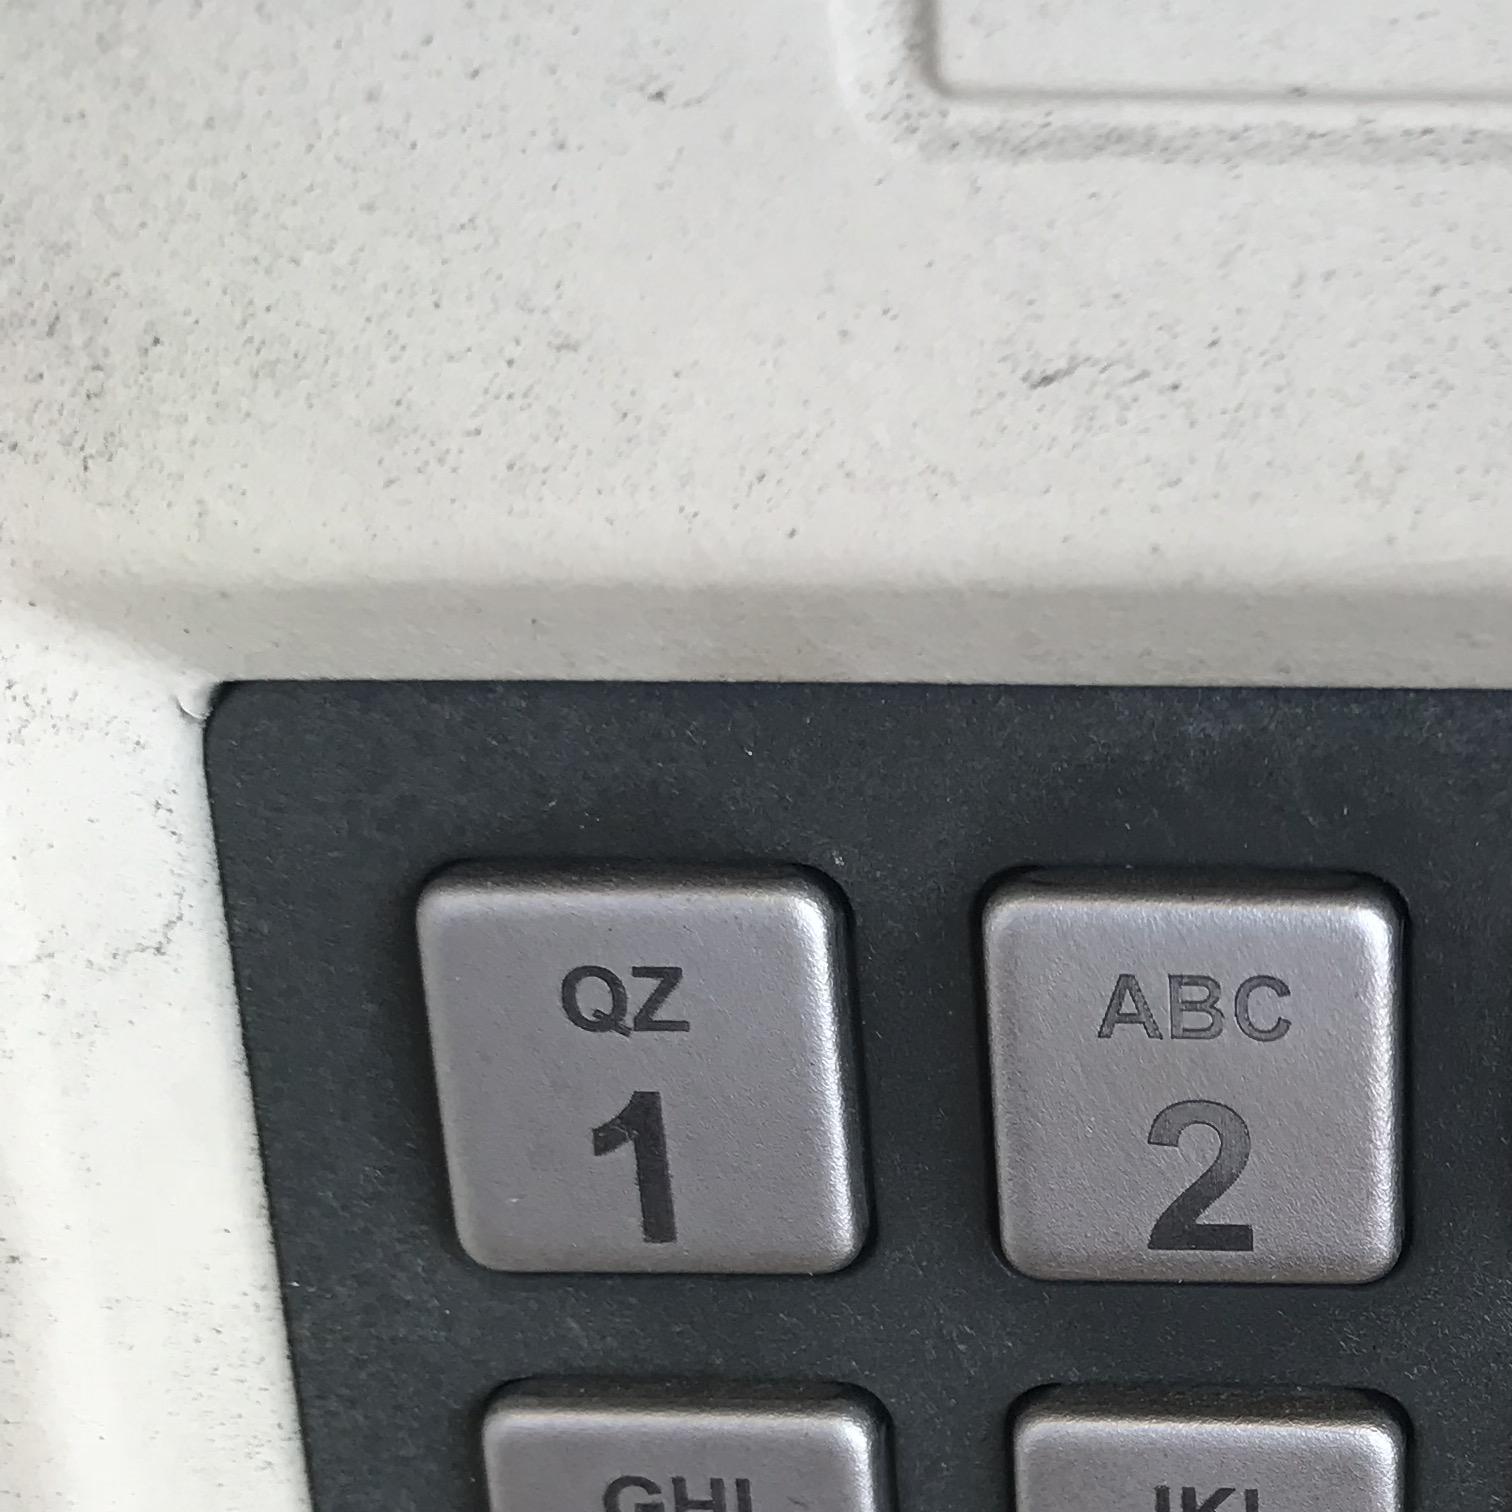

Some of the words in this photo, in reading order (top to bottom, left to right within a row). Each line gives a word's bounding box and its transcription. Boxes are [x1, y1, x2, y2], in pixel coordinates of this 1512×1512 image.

[560, 965, 690, 1037] QZ
[1097, 973, 1292, 1043] ABC
[591, 1091, 677, 1244] 1
[1147, 1099, 1254, 1251] 2
